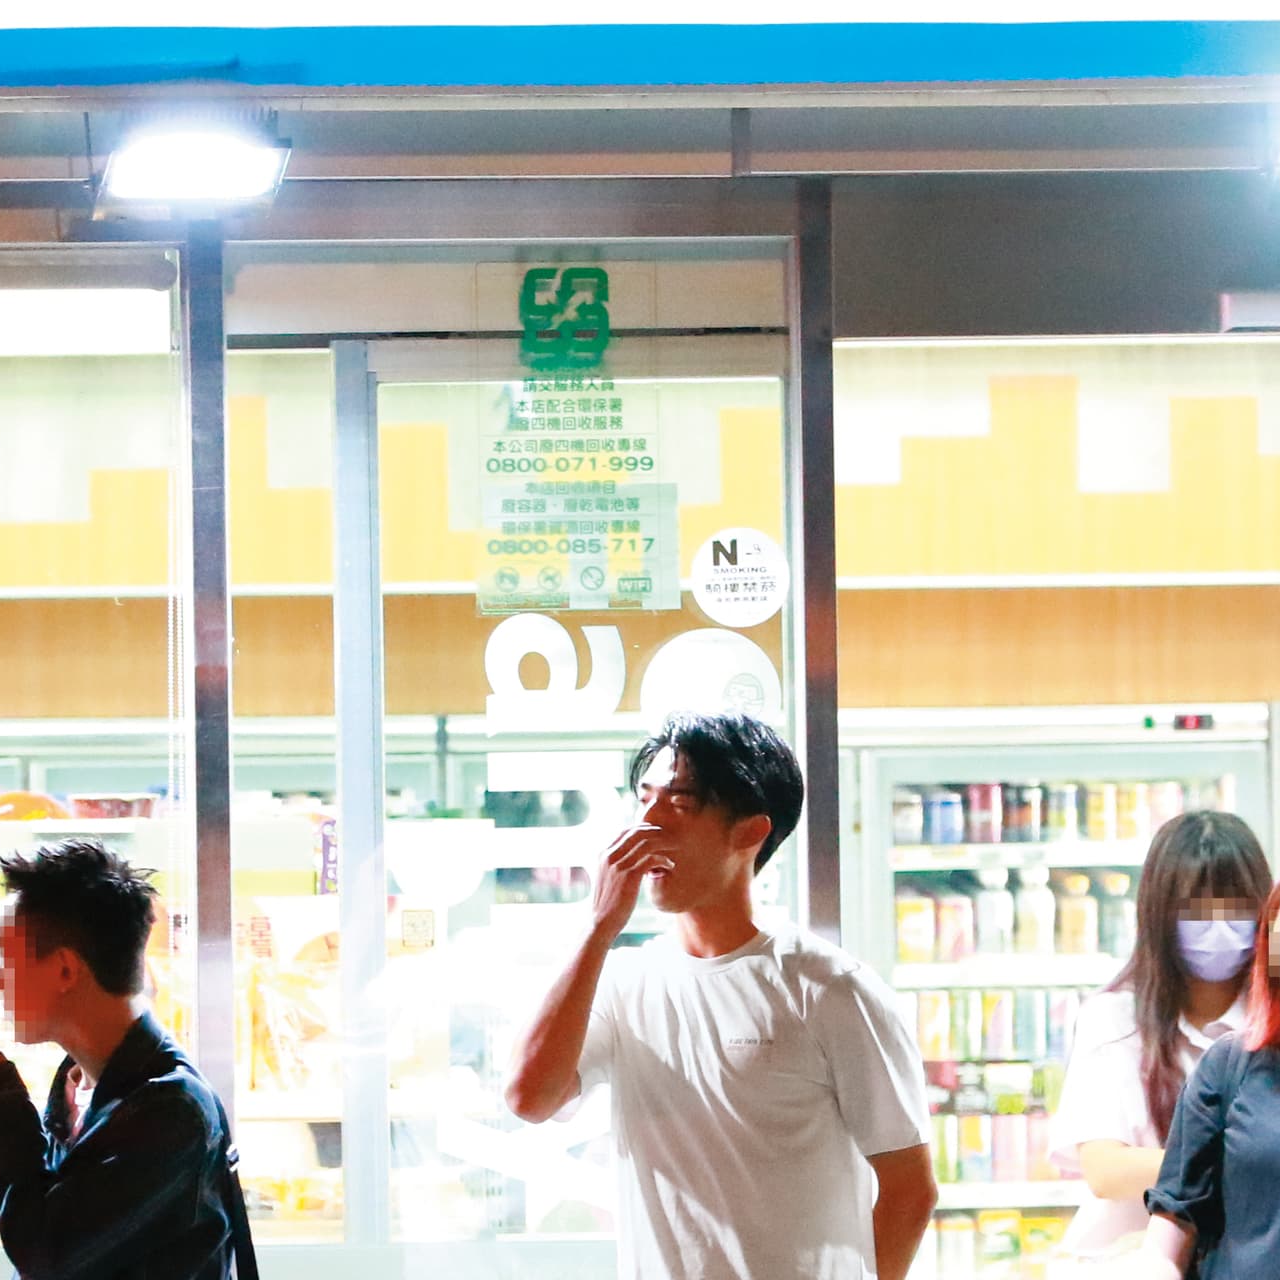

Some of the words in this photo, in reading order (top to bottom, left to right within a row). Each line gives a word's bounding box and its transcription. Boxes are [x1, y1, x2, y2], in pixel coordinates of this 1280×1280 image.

[486, 456, 654, 473] 0800-071-999
[487, 538, 655, 554] 0800-085-717
[713, 566, 768, 574] SMOKING
